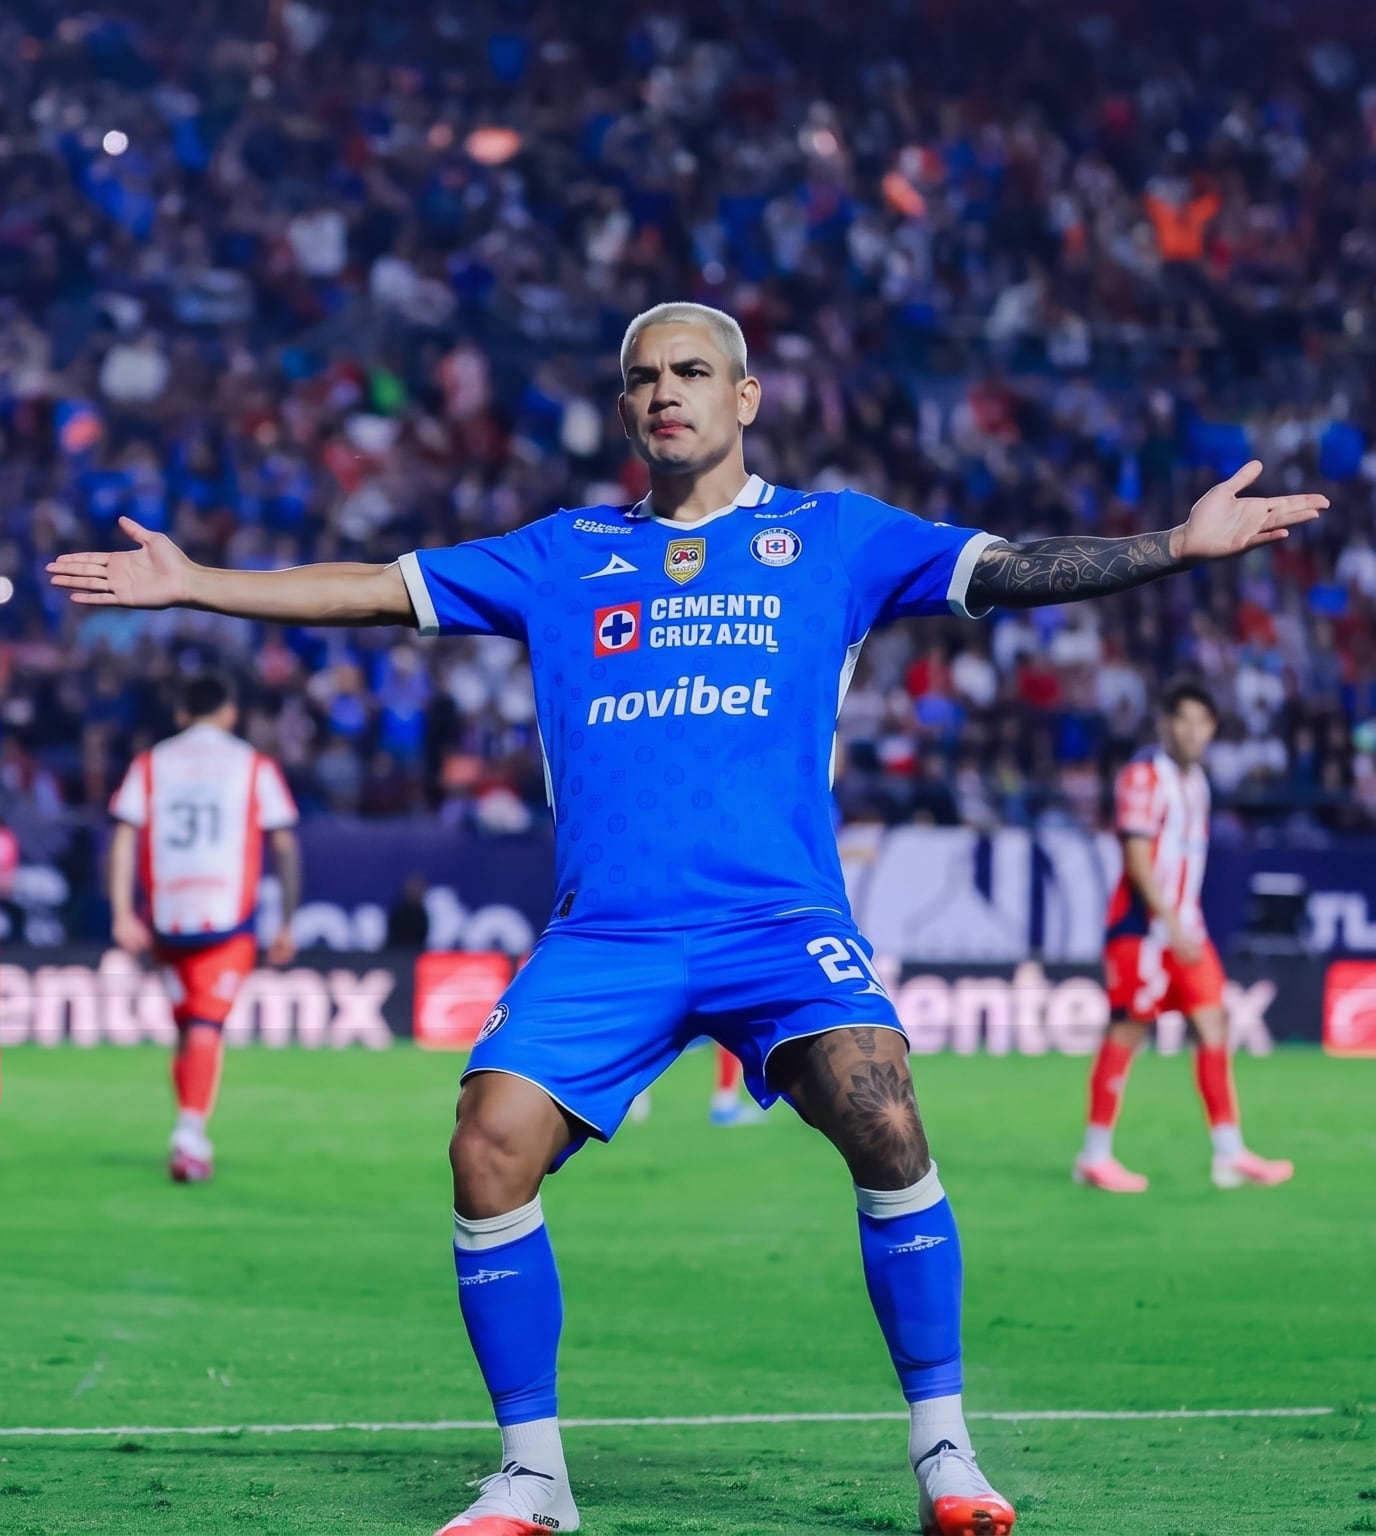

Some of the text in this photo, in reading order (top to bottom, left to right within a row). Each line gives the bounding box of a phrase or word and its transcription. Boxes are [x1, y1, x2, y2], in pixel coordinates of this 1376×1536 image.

[650, 595, 781, 621] CEMENTO
[649, 623, 779, 649] CRUZ AZUL
[587, 675, 772, 726] novibet
[167, 800, 222, 850] 31
[806, 936, 886, 986] 21
